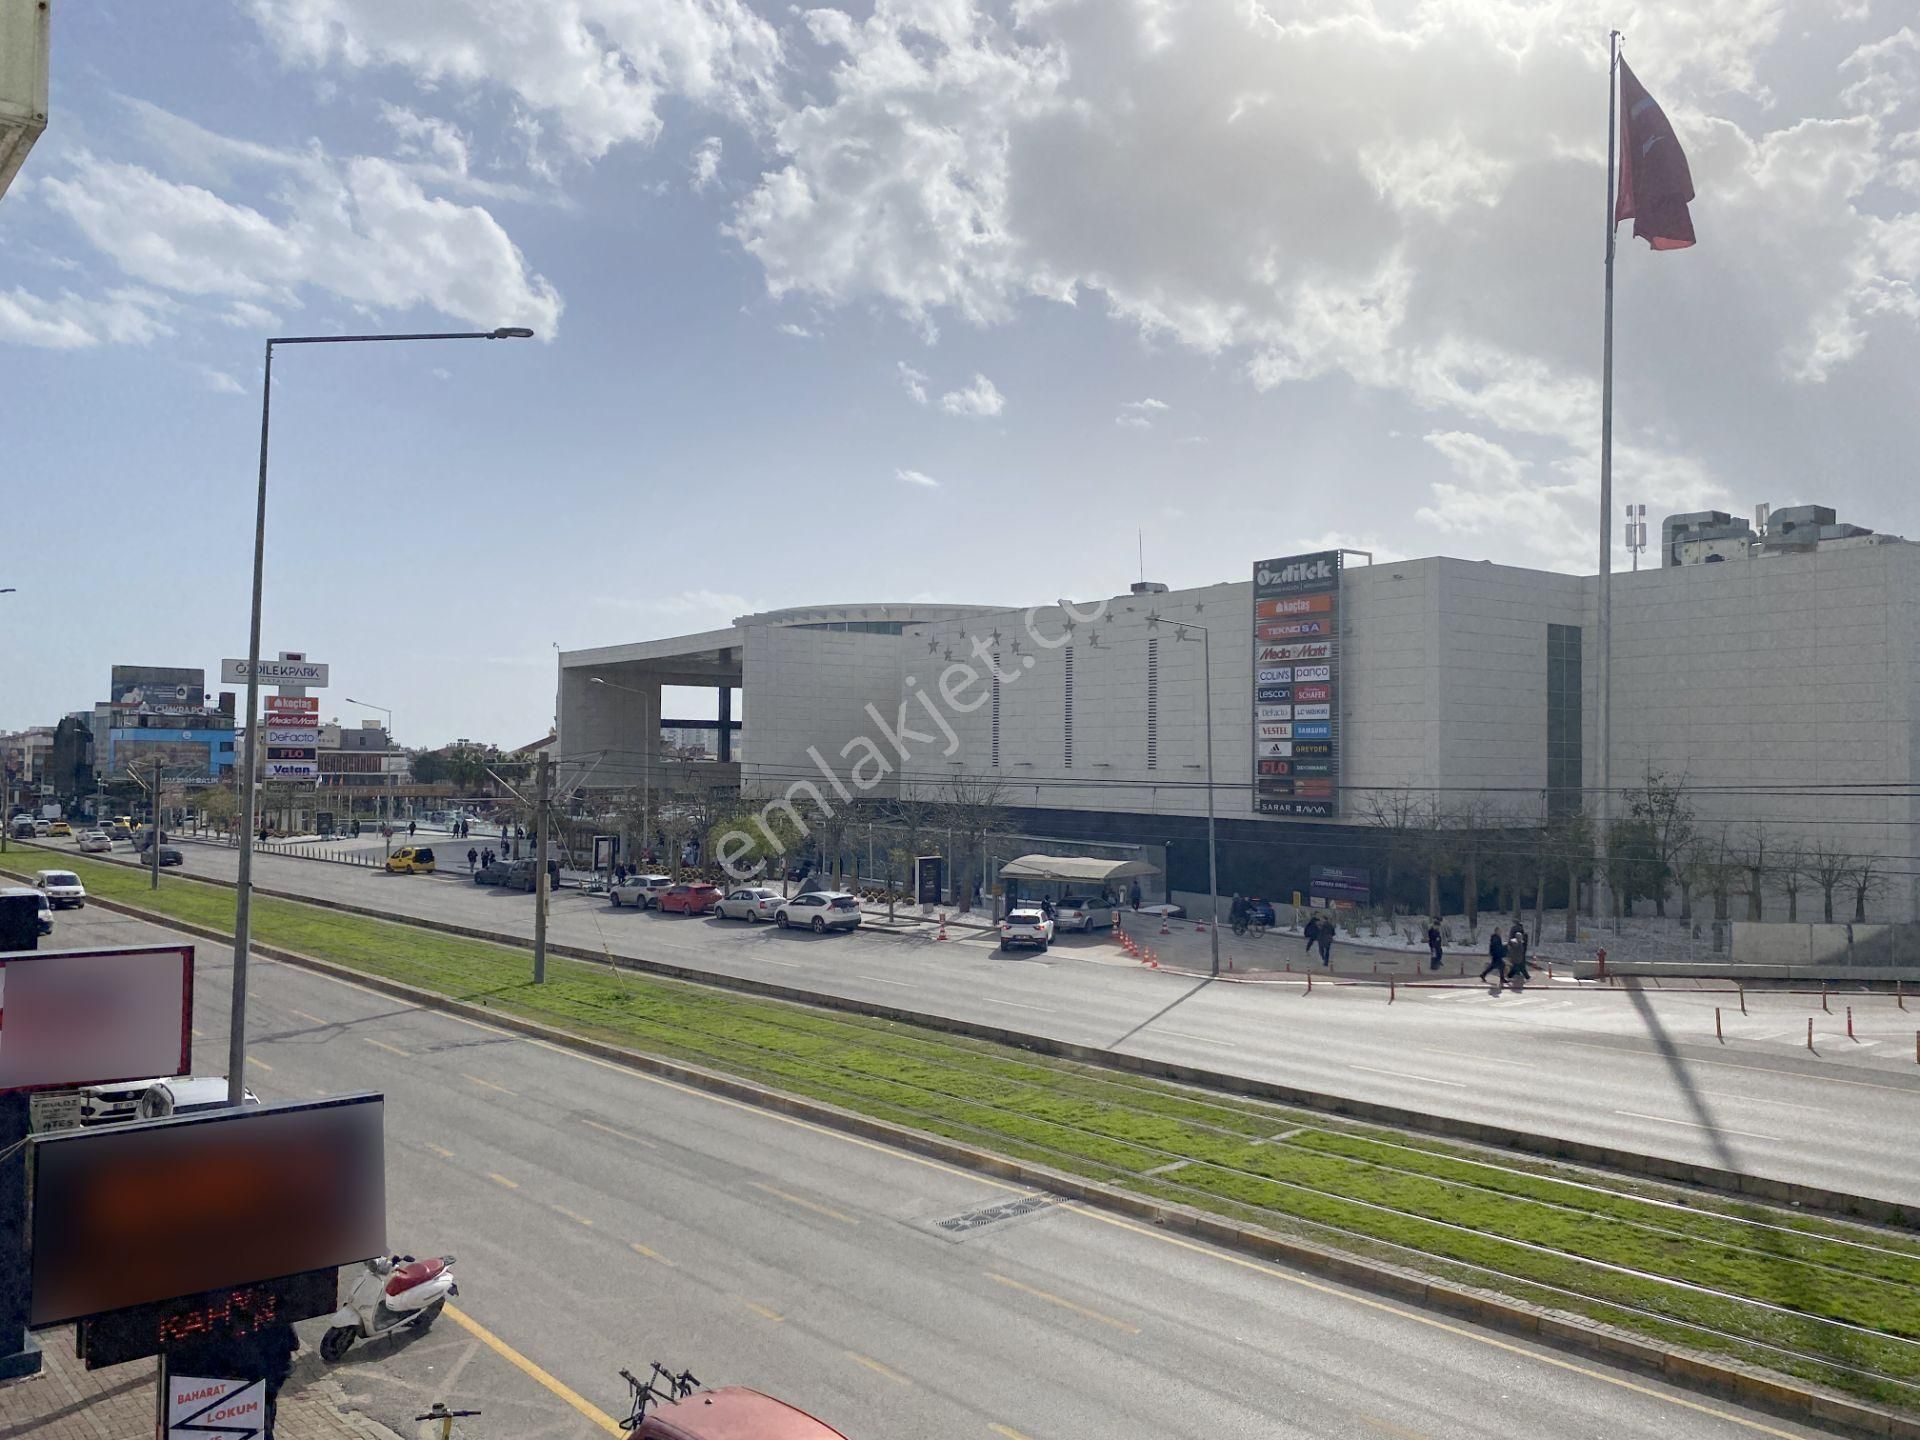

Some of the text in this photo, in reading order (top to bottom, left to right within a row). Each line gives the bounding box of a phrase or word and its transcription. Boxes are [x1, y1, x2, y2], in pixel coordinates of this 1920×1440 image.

[1257, 560, 1332, 586] Özdilek
[236, 662, 320, 678] ÖDİLEKPARK
[1297, 667, 1329, 680] panço
[269, 731, 315, 743] DeFacto
[1262, 727, 1288, 735] VESTEL
[280, 749, 305, 758] FLO
[1295, 745, 1328, 753] GREYDER
[273, 765, 310, 774] Vatan
[1262, 761, 1288, 774] FLO
[1262, 803, 1292, 812] SARAR
[177, 1384, 226, 1404] BAHARAT
[206, 1402, 258, 1424] LOKUM
